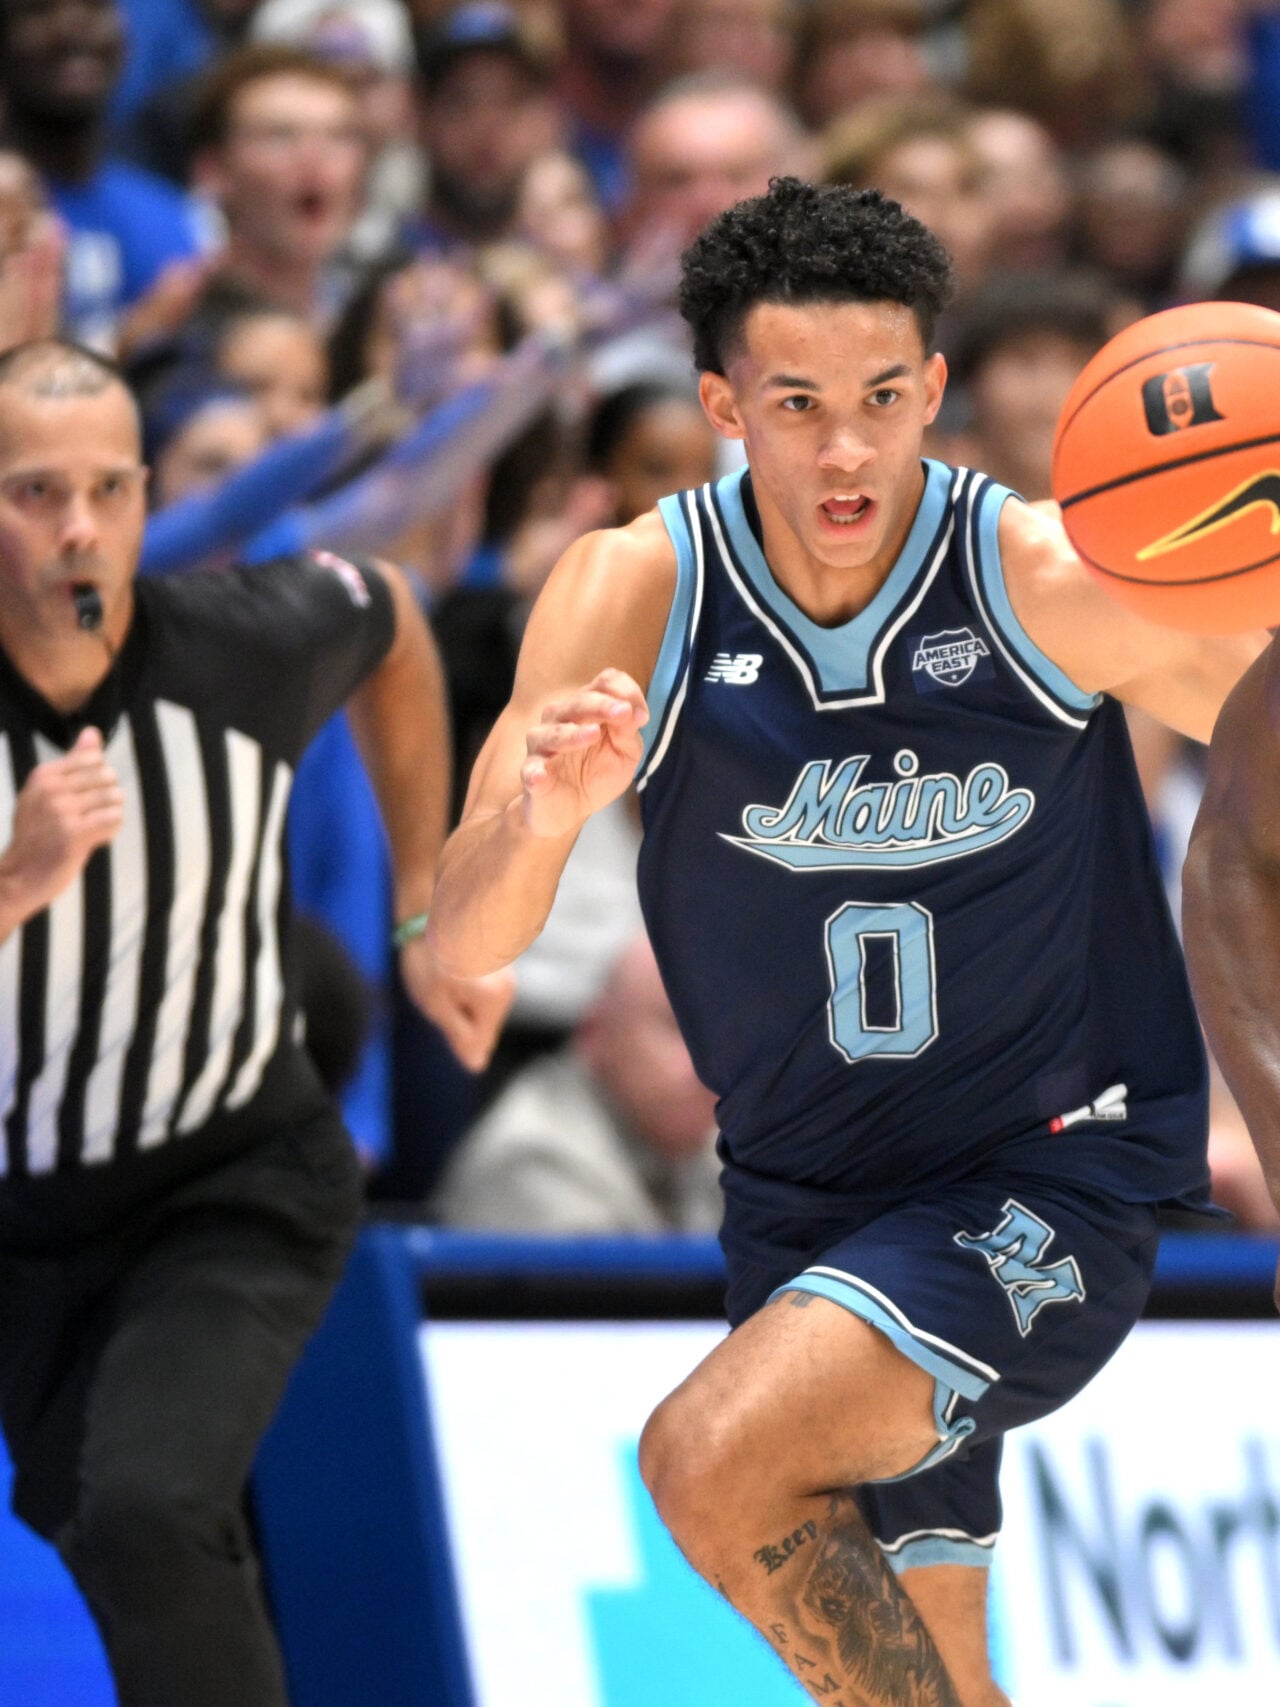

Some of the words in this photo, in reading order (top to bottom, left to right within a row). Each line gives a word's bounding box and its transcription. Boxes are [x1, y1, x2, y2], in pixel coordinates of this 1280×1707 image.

[914, 640, 988, 669] AMERICA
[931, 655, 971, 673] EAST
[738, 749, 1035, 856] Maine
[824, 901, 939, 1063] 0
[753, 1519, 817, 1577] Keep
[770, 1621, 847, 1707] FAM
